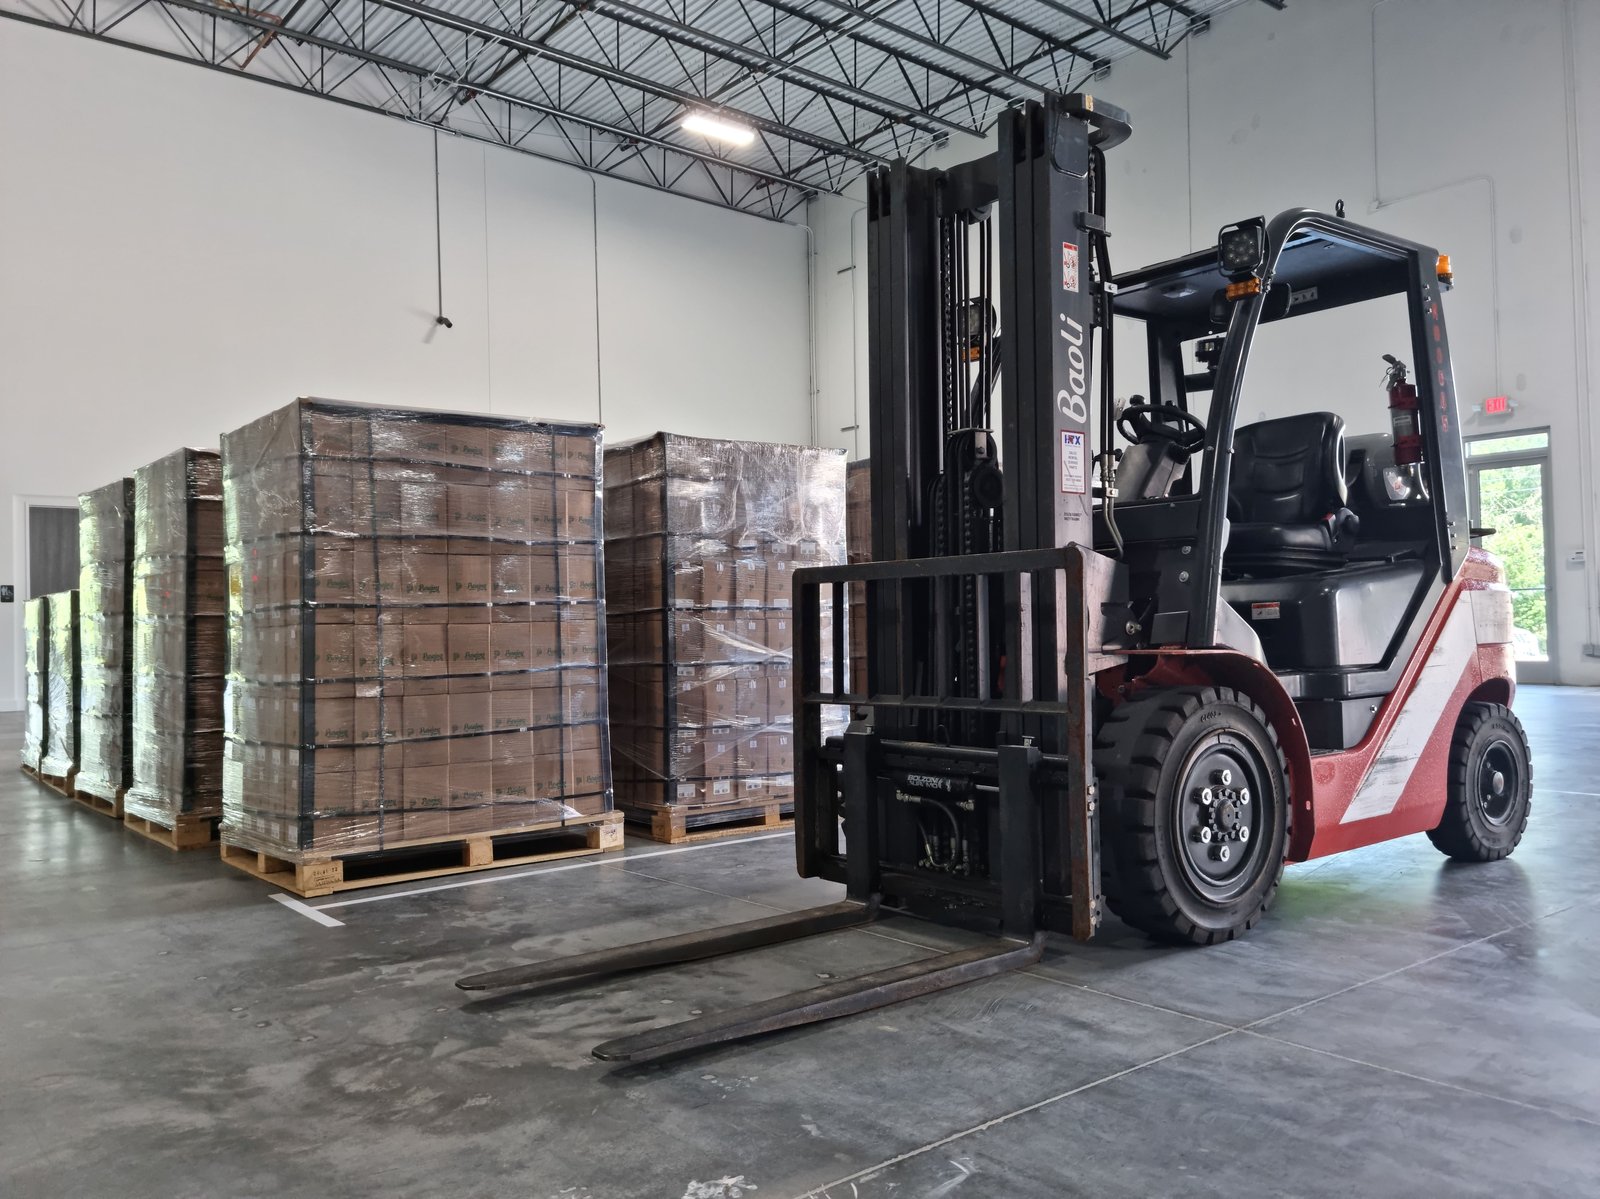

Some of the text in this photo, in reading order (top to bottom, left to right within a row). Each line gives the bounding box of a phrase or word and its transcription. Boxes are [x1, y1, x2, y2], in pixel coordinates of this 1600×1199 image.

[1057, 313, 1087, 424] Baoli
[1487, 398, 1505, 413] EXIT
[907, 774, 939, 783] BOLZONI
